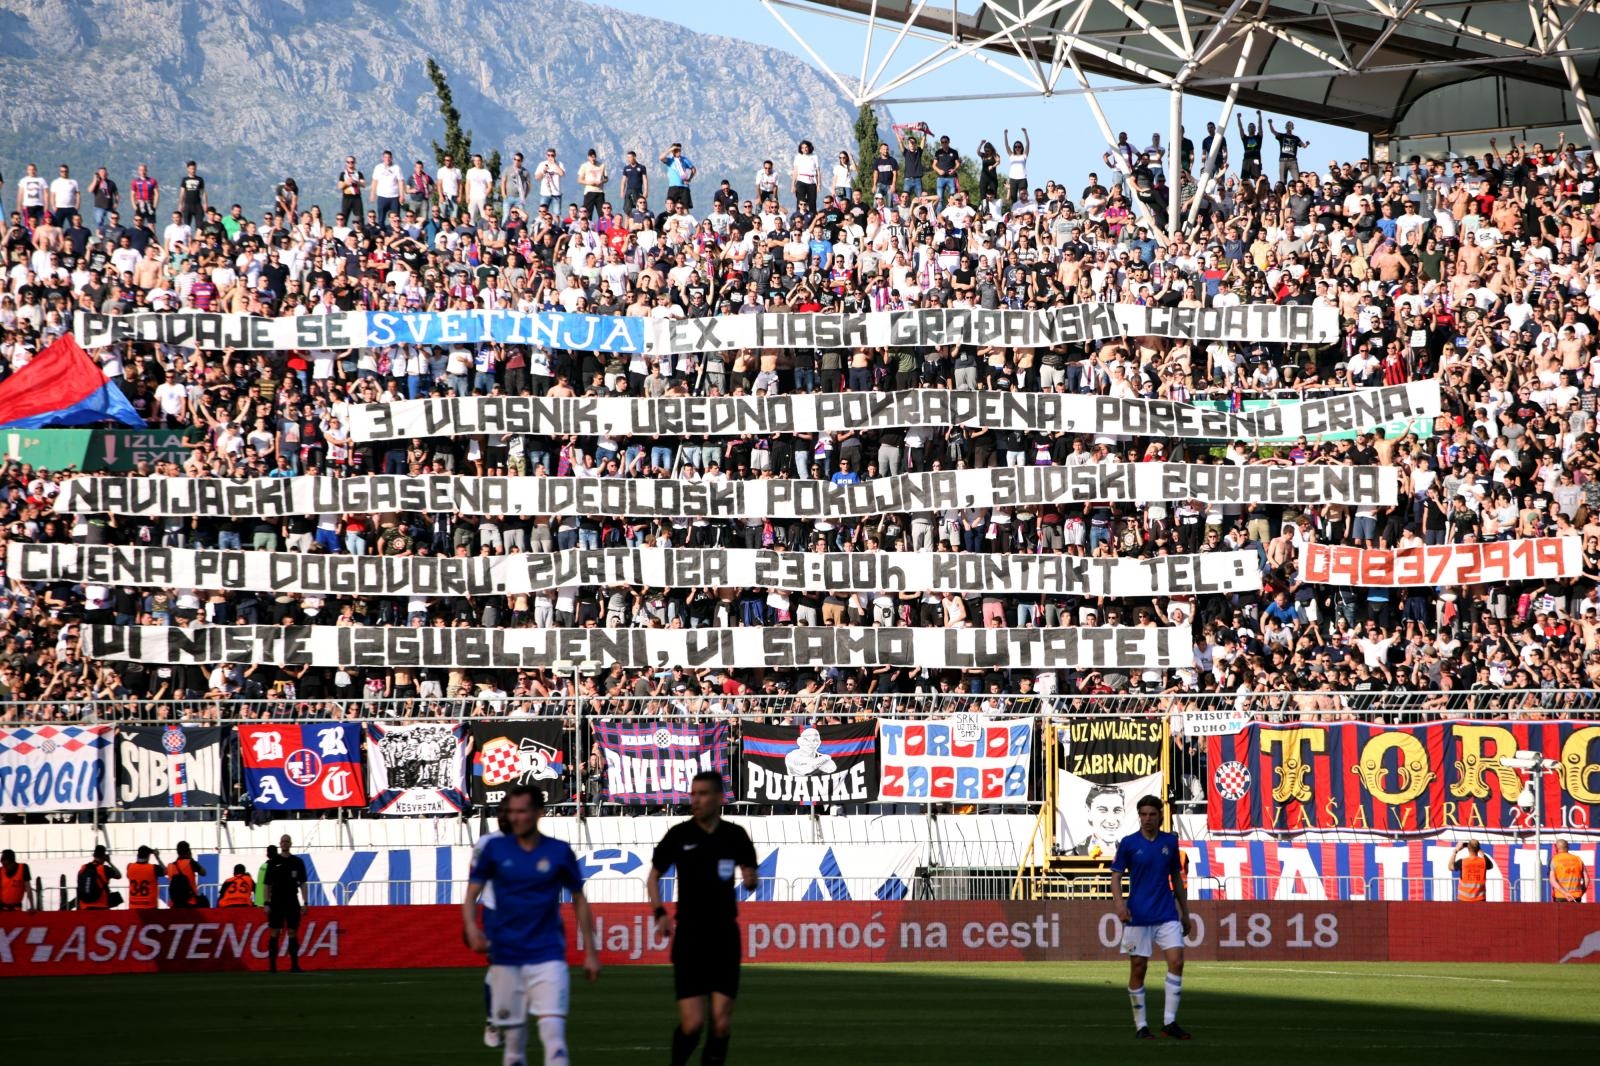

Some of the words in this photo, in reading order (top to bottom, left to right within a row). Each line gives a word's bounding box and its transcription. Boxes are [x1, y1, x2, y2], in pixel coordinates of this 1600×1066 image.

[83, 313, 274, 348] PRODAJE
[296, 312, 351, 346] SE
[670, 317, 734, 349] EX.
[756, 313, 868, 346] HASK
[1145, 305, 1327, 344] CROATIA,
[365, 402, 405, 439] 3.
[424, 397, 613, 434] VLASNIK,
[631, 395, 796, 435] UREDNO
[815, 389, 1075, 432] POKRADENA,
[1096, 396, 1284, 438] POREZNO
[1300, 385, 1425, 435] CRNA.
[68, 477, 294, 516] NAVIJAČKI
[538, 476, 746, 517] IDEOLOŠKI
[766, 471, 975, 515] POKOJNA,
[991, 463, 1136, 502] SUDSKI
[20, 544, 172, 583] CIJENA
[195, 551, 245, 588] PO
[269, 551, 506, 595] DOGOVORU.
[527, 548, 643, 586] ZVATI
[664, 549, 728, 586] IZA
[755, 552, 906, 591] 23:00h
[932, 554, 1118, 595] KONTAKT
[1140, 557, 1245, 593] TEL.:
[1305, 537, 1566, 586] 098372919
[168, 625, 313, 665] NISTE
[763, 627, 914, 667] SAMO
[945, 628, 1170, 667] LUTATE!
[1071, 722, 1088, 742] UZ
[1090, 717, 1148, 741] NAVIJAČE
[1186, 711, 1252, 721] PRISUTAN
[1193, 721, 1242, 733] DUHOM
[250, 731, 284, 762] B
[1072, 753, 1159, 776] ZABRANOM
[0, 758, 105, 807] TROGIR
[254, 775, 288, 804] A
[747, 760, 868, 802] PUJANKE
[881, 765, 1027, 798] ZAGREB
[129, 879, 150, 897] 36
[748, 912, 885, 958] pomoć
[900, 921, 948, 949] na
[962, 912, 1060, 949] cesti
[1220, 913, 1272, 949] 18
[1287, 913, 1339, 949] 18
